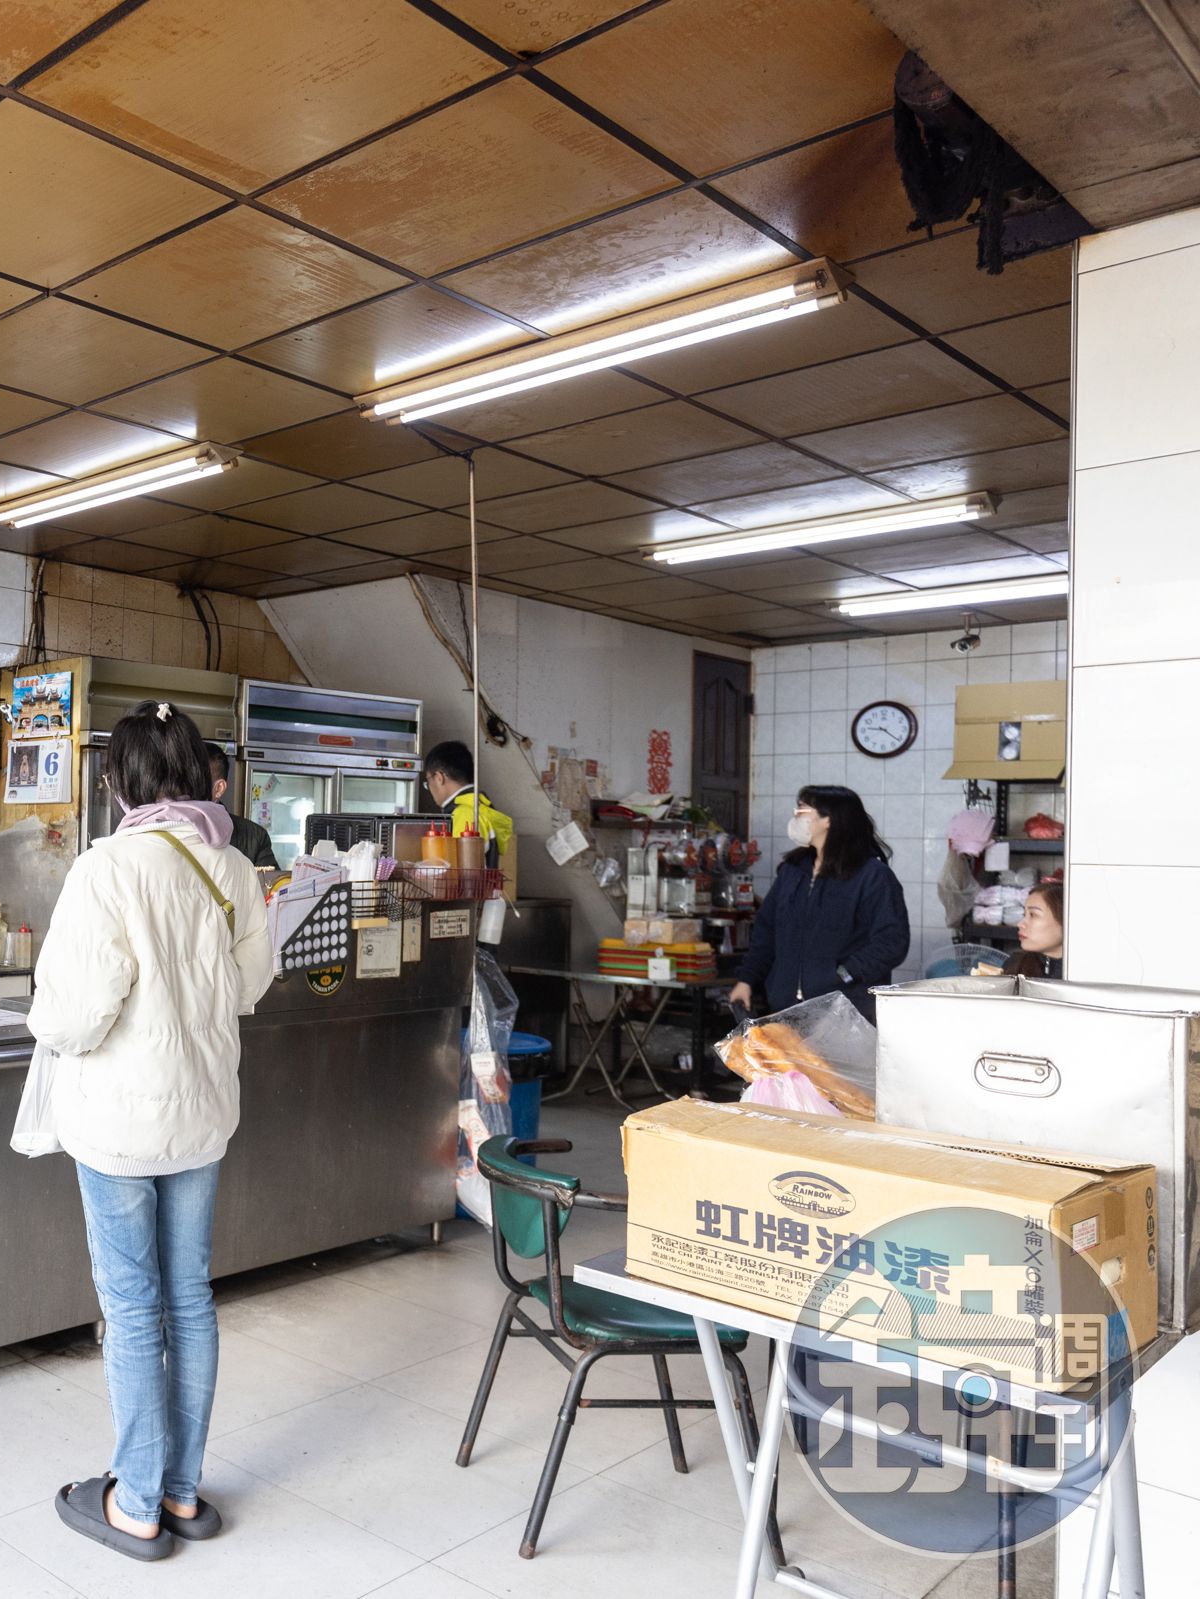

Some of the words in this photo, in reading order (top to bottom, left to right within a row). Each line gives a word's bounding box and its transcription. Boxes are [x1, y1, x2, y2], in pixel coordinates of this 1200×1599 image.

[44, 752, 59, 776] 6
[793, 1184, 833, 1200] RAINBOW
[696, 1200, 950, 1295] 虹牌油漆
[651, 1243, 676, 1254] YUNG
[678, 1251, 693, 1259] CHI
[695, 1256, 723, 1267] PAINT
[735, 1265, 779, 1281] VARNISH
[651, 1233, 849, 1292] 永記造漆工業股份有限公司
[775, 1292, 793, 1301] FAX
[776, 1285, 792, 1293] TEL
